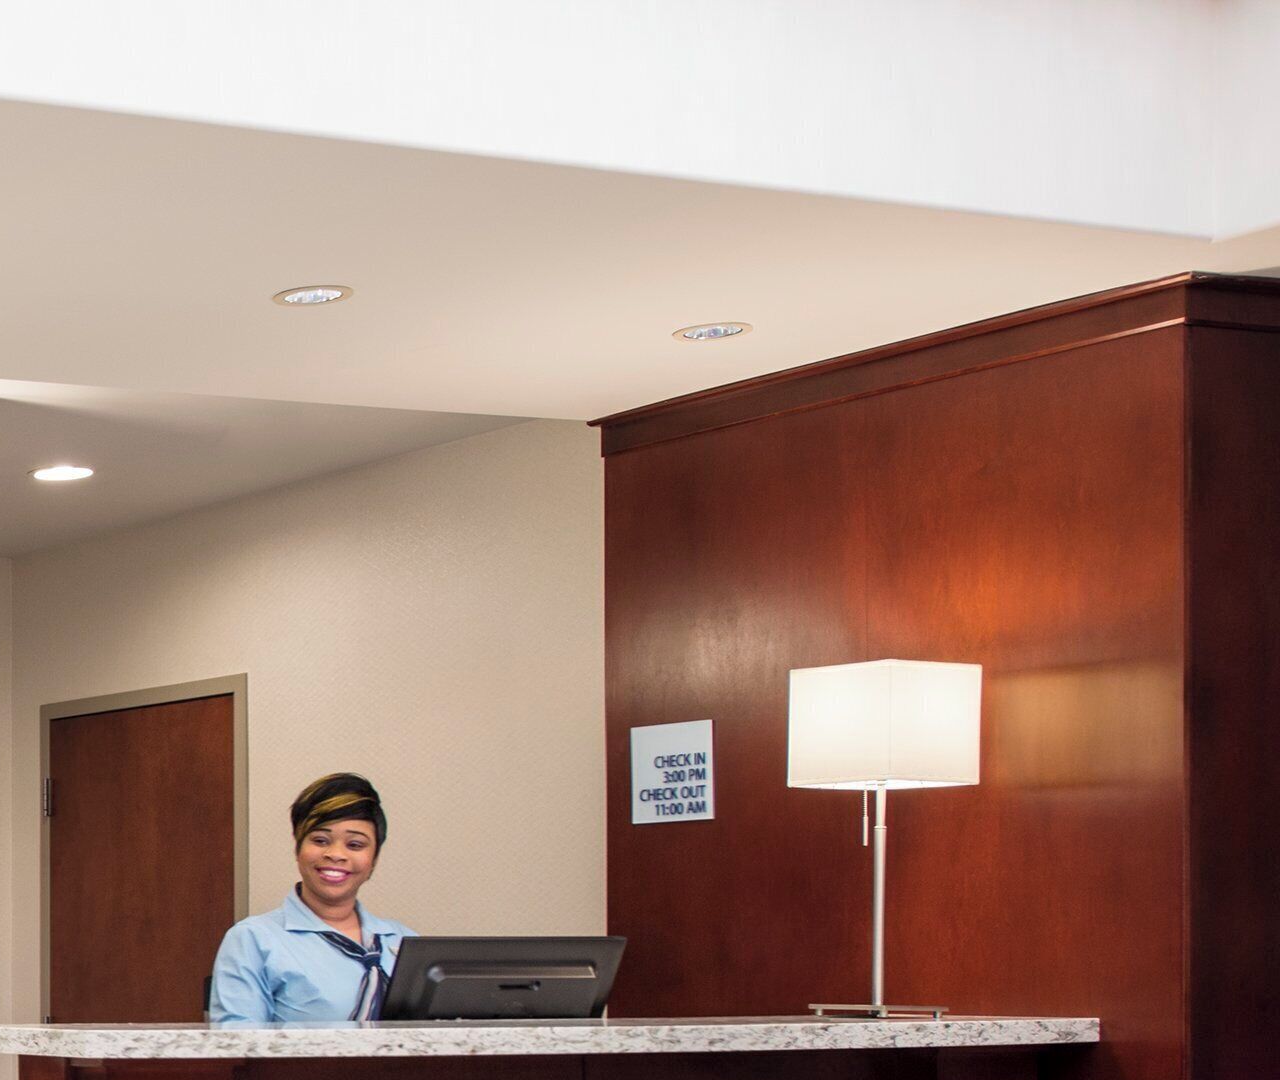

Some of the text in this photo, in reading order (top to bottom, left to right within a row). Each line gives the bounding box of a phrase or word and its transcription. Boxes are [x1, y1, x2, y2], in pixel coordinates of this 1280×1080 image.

[654, 752, 706, 768] CHECK IN
[662, 768, 706, 784] 3:00 PM
[639, 785, 707, 801] CHECK OUT
[654, 801, 707, 816] 11:00 AM
